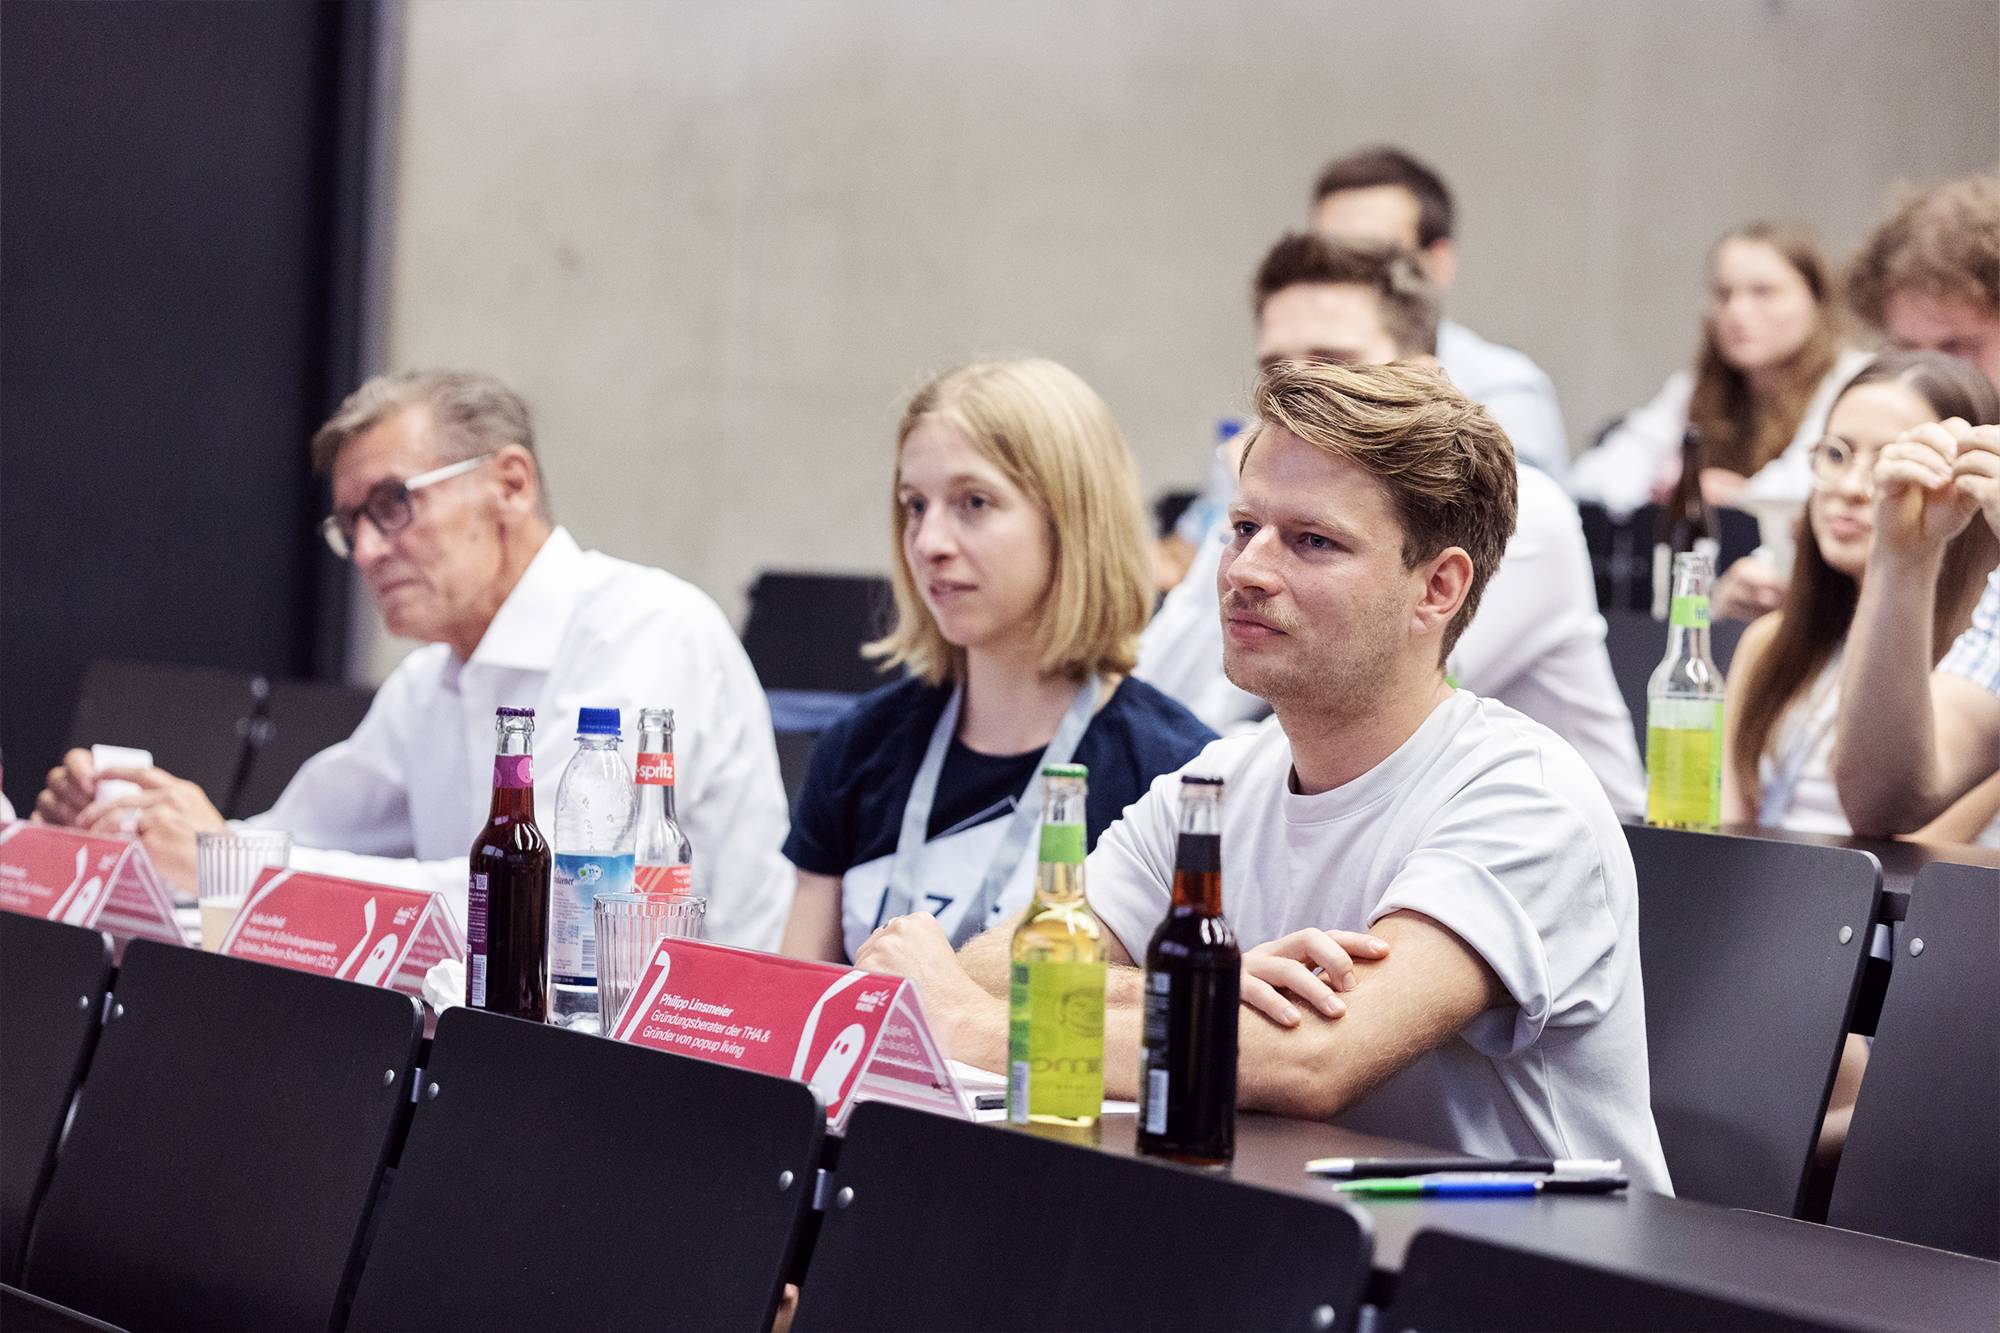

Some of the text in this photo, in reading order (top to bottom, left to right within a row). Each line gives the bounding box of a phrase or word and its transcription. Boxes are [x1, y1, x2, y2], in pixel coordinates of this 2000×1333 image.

[659, 993, 734, 1017] Philipp Linsmeier
[643, 1025, 745, 1058] Gründer von popup living
[651, 1009, 771, 1043] Gründungsberater der THA &
